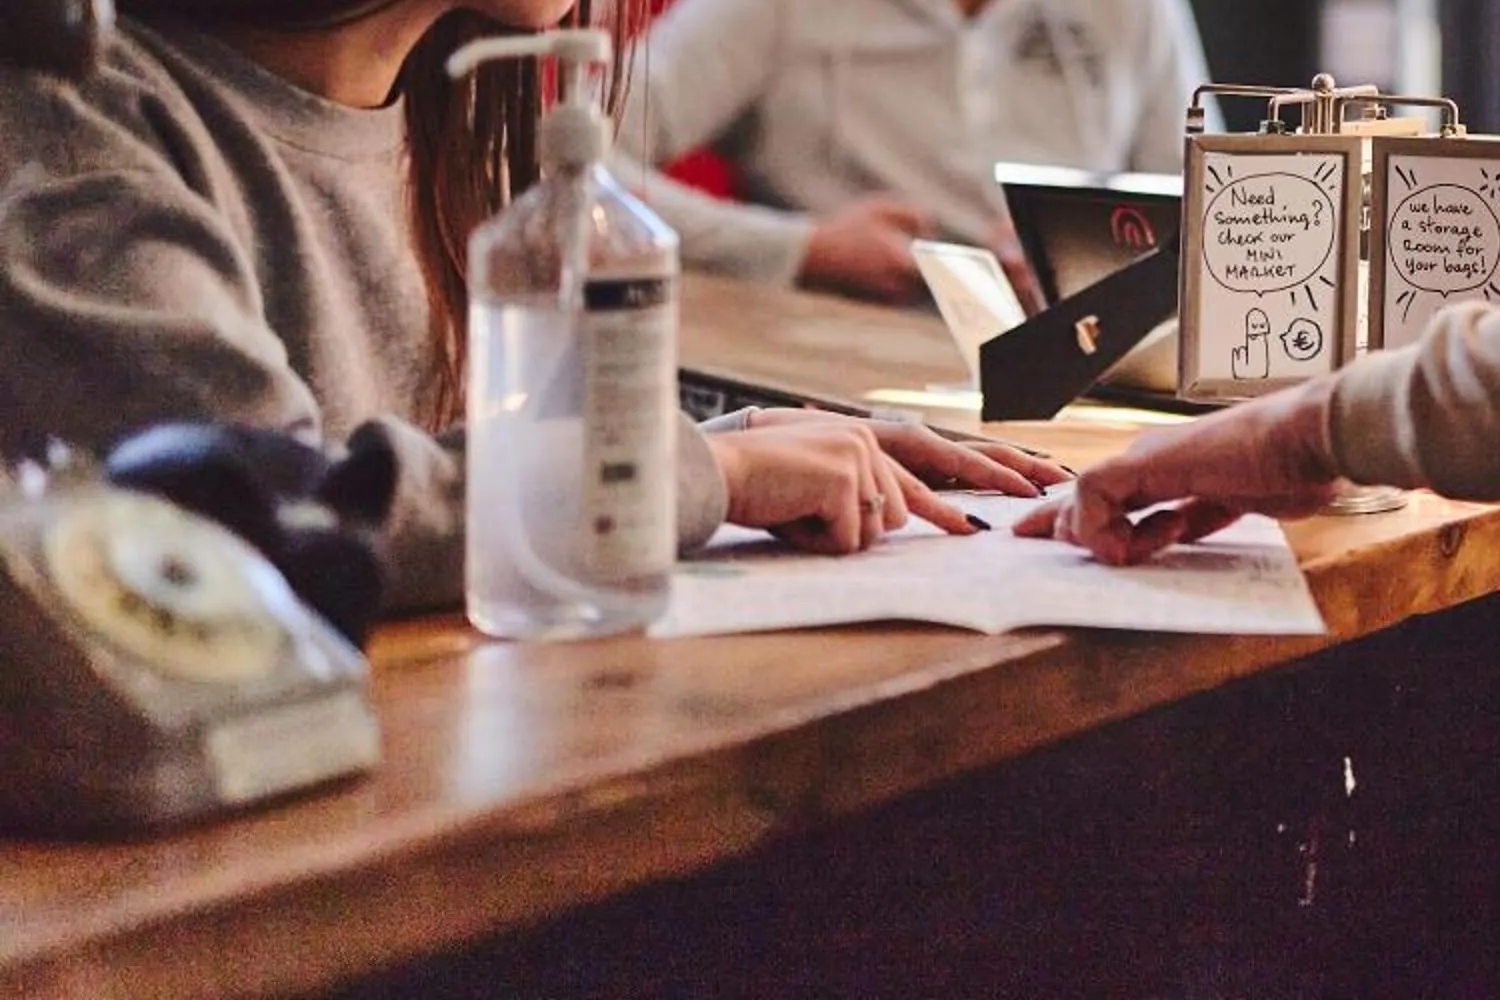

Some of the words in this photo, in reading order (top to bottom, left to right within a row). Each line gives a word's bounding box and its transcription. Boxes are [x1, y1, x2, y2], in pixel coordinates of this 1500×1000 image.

[1231, 186, 1275, 207] Need
[1433, 194, 1474, 215] have
[1270, 233, 1296, 243] our
[1401, 219, 1412, 231] a
[1418, 216, 1483, 240] storage
[1456, 239, 1485, 258] for
[1405, 258, 1438, 275] your
[1444, 256, 1487, 279] bags!
